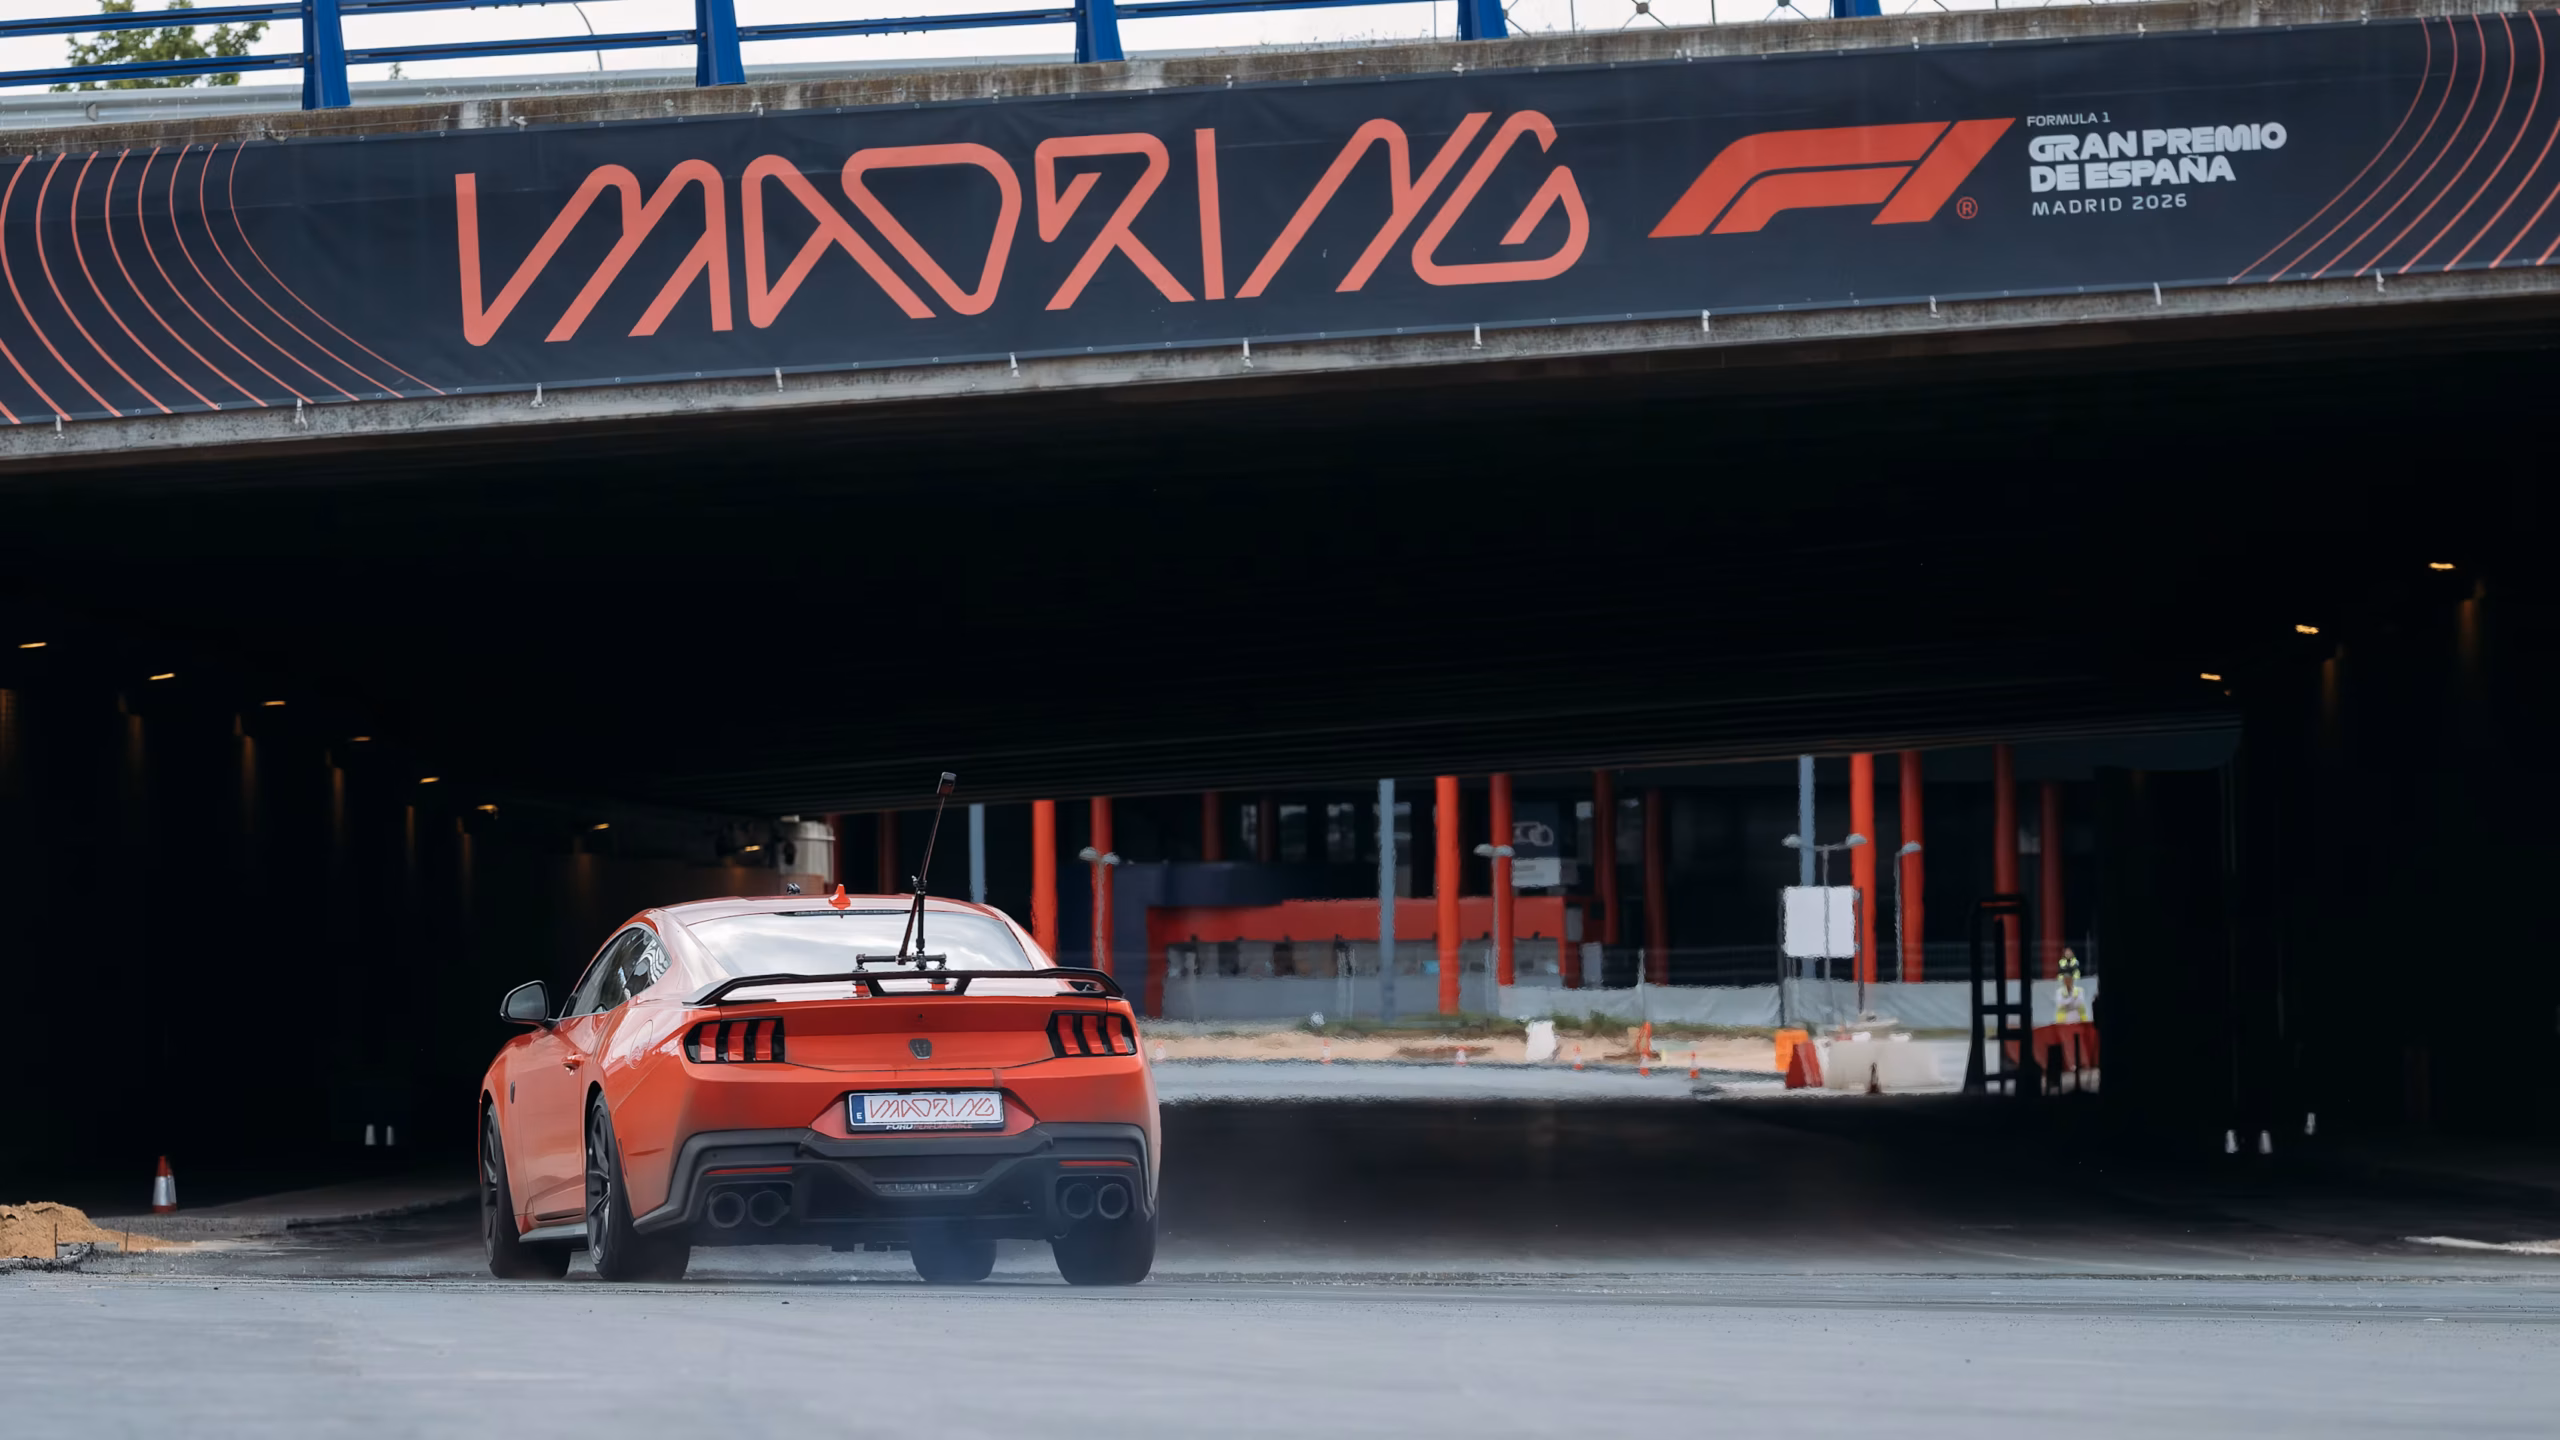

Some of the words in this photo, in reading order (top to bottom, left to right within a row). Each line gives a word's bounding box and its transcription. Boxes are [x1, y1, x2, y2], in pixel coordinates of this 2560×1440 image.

[2026, 112, 2098, 127] FORMULA
[2102, 111, 2111, 123] 1
[2028, 130, 2138, 162] GRAN
[2142, 121, 2288, 157] PREMIO
[2029, 163, 2081, 193] DE
[2084, 154, 2237, 190] ESPAÑA
[2031, 197, 2122, 217] MADRID
[2131, 193, 2187, 211] 2026
[455, 110, 1589, 346] MADRING
[856, 1112, 863, 1120] E
